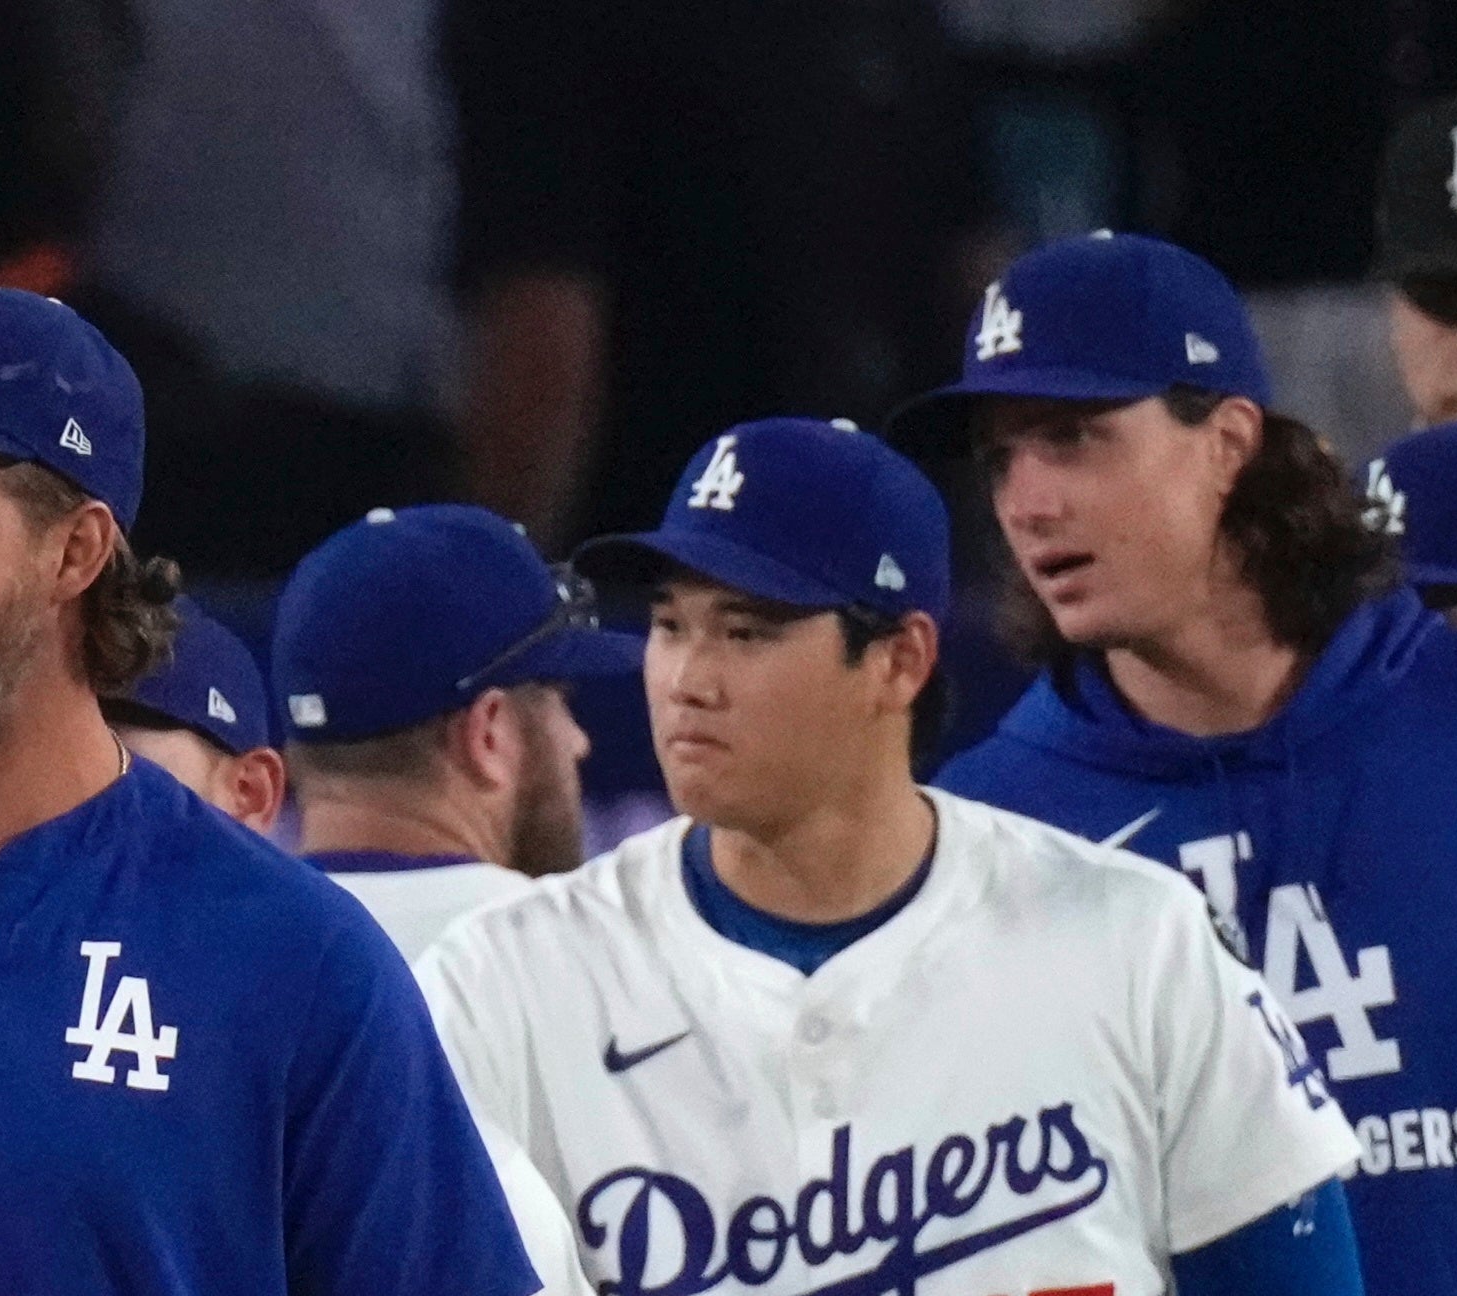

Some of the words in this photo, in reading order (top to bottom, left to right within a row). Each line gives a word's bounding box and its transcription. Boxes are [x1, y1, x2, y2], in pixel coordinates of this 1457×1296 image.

[975, 281, 1023, 361] LA
[687, 434, 745, 511] LA
[65, 940, 178, 1091] LA
